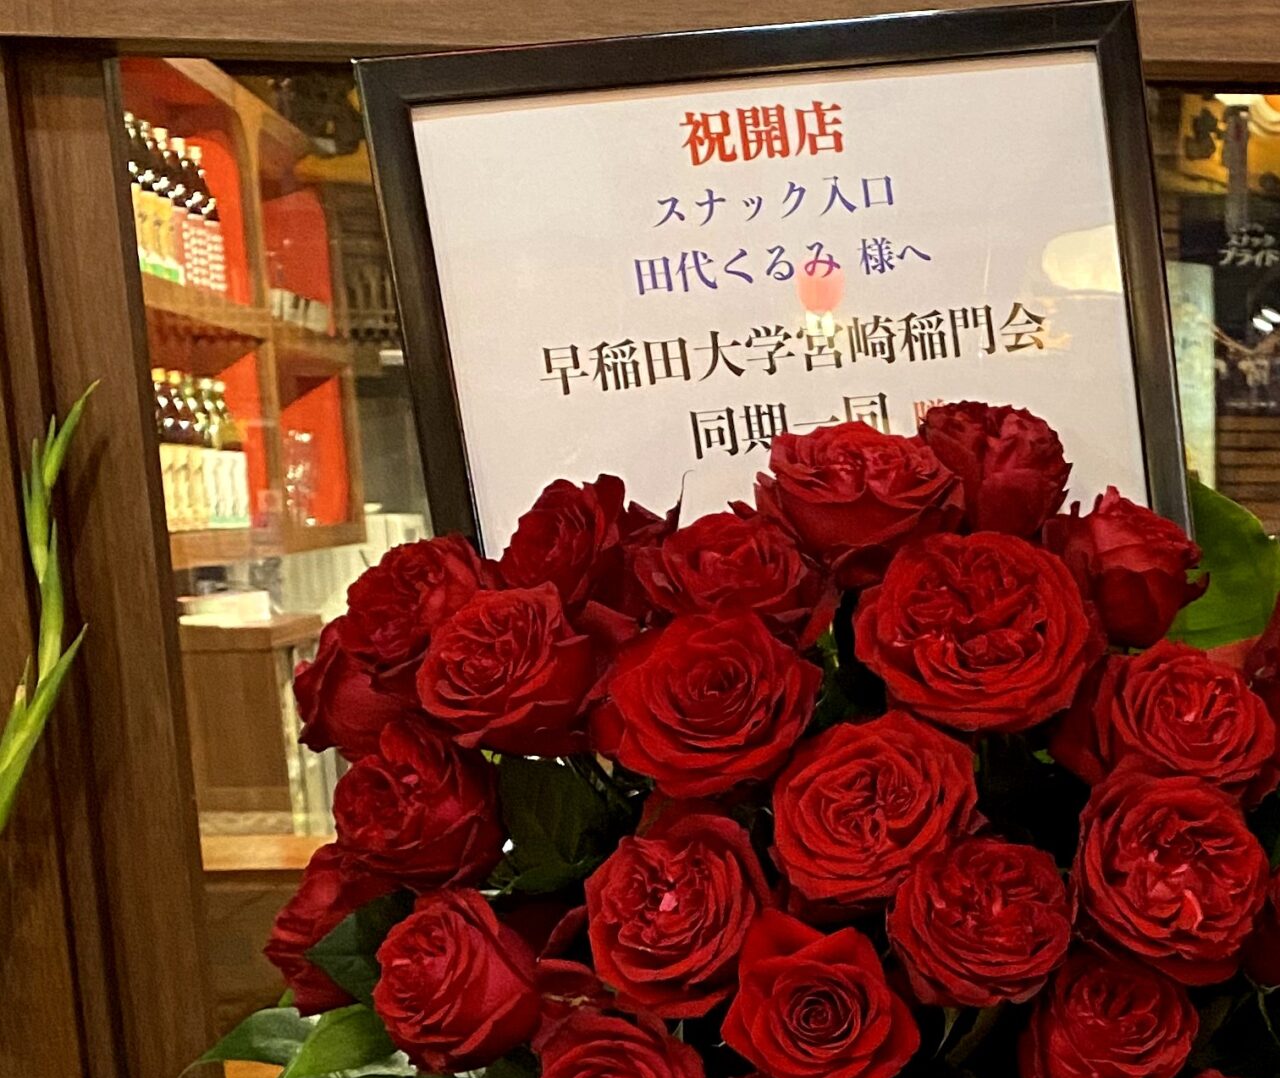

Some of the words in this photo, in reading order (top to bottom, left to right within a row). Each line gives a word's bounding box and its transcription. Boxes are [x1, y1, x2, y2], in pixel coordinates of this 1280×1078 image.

[679, 101, 844, 166] 祝開店
[653, 175, 894, 228] スナック入口
[634, 242, 840, 295] 田代くるみ
[858, 237, 931, 275] 様へ
[540, 302, 1046, 395] 早稲田大学宮崎稲門会
